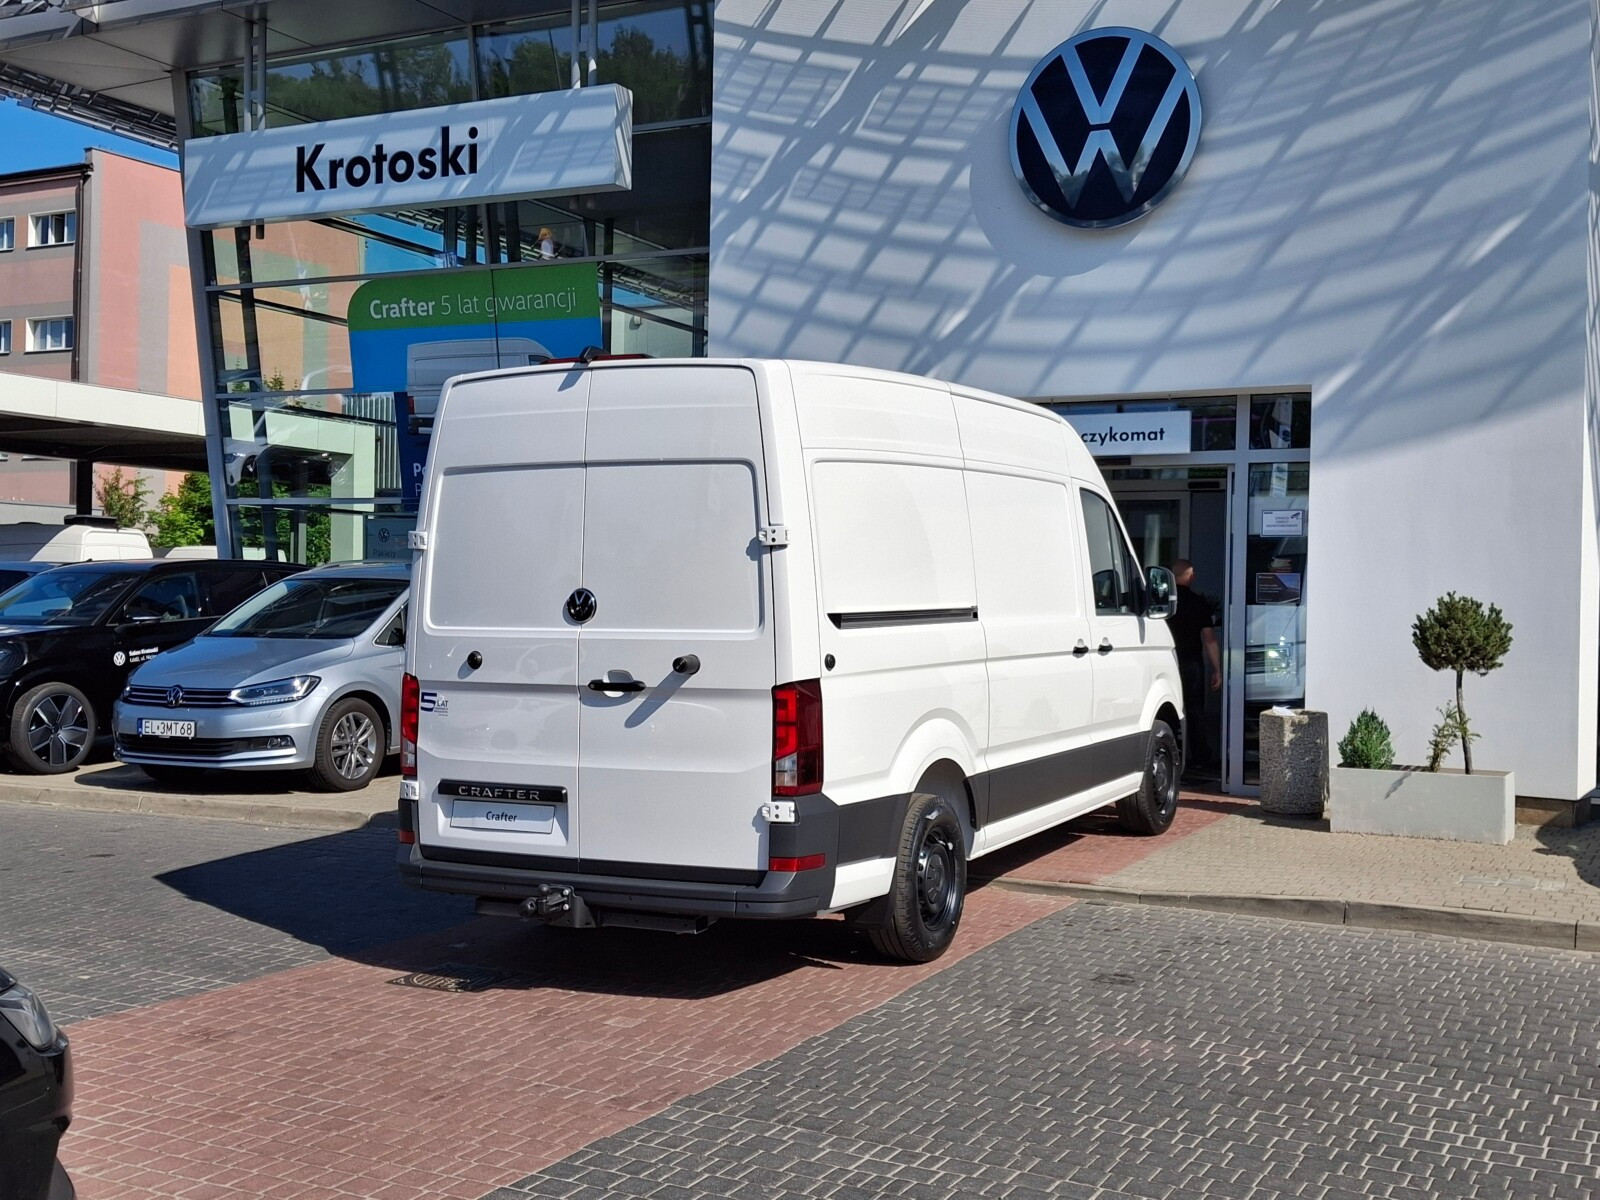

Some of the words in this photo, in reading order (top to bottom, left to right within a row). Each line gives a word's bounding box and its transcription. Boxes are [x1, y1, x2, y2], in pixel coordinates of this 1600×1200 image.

[296, 125, 479, 193] Krotoski
[369, 297, 435, 319] Crafter
[440, 295, 451, 315] 5
[457, 293, 480, 314] lat
[485, 287, 577, 317] gwarancji
[1081, 426, 1166, 446] czykomat
[420, 691, 437, 712] 5
[144, 720, 157, 735] EL
[160, 721, 193, 736] 3MT68
[458, 785, 540, 801] CRAFTER
[485, 810, 518, 823] Crafter
